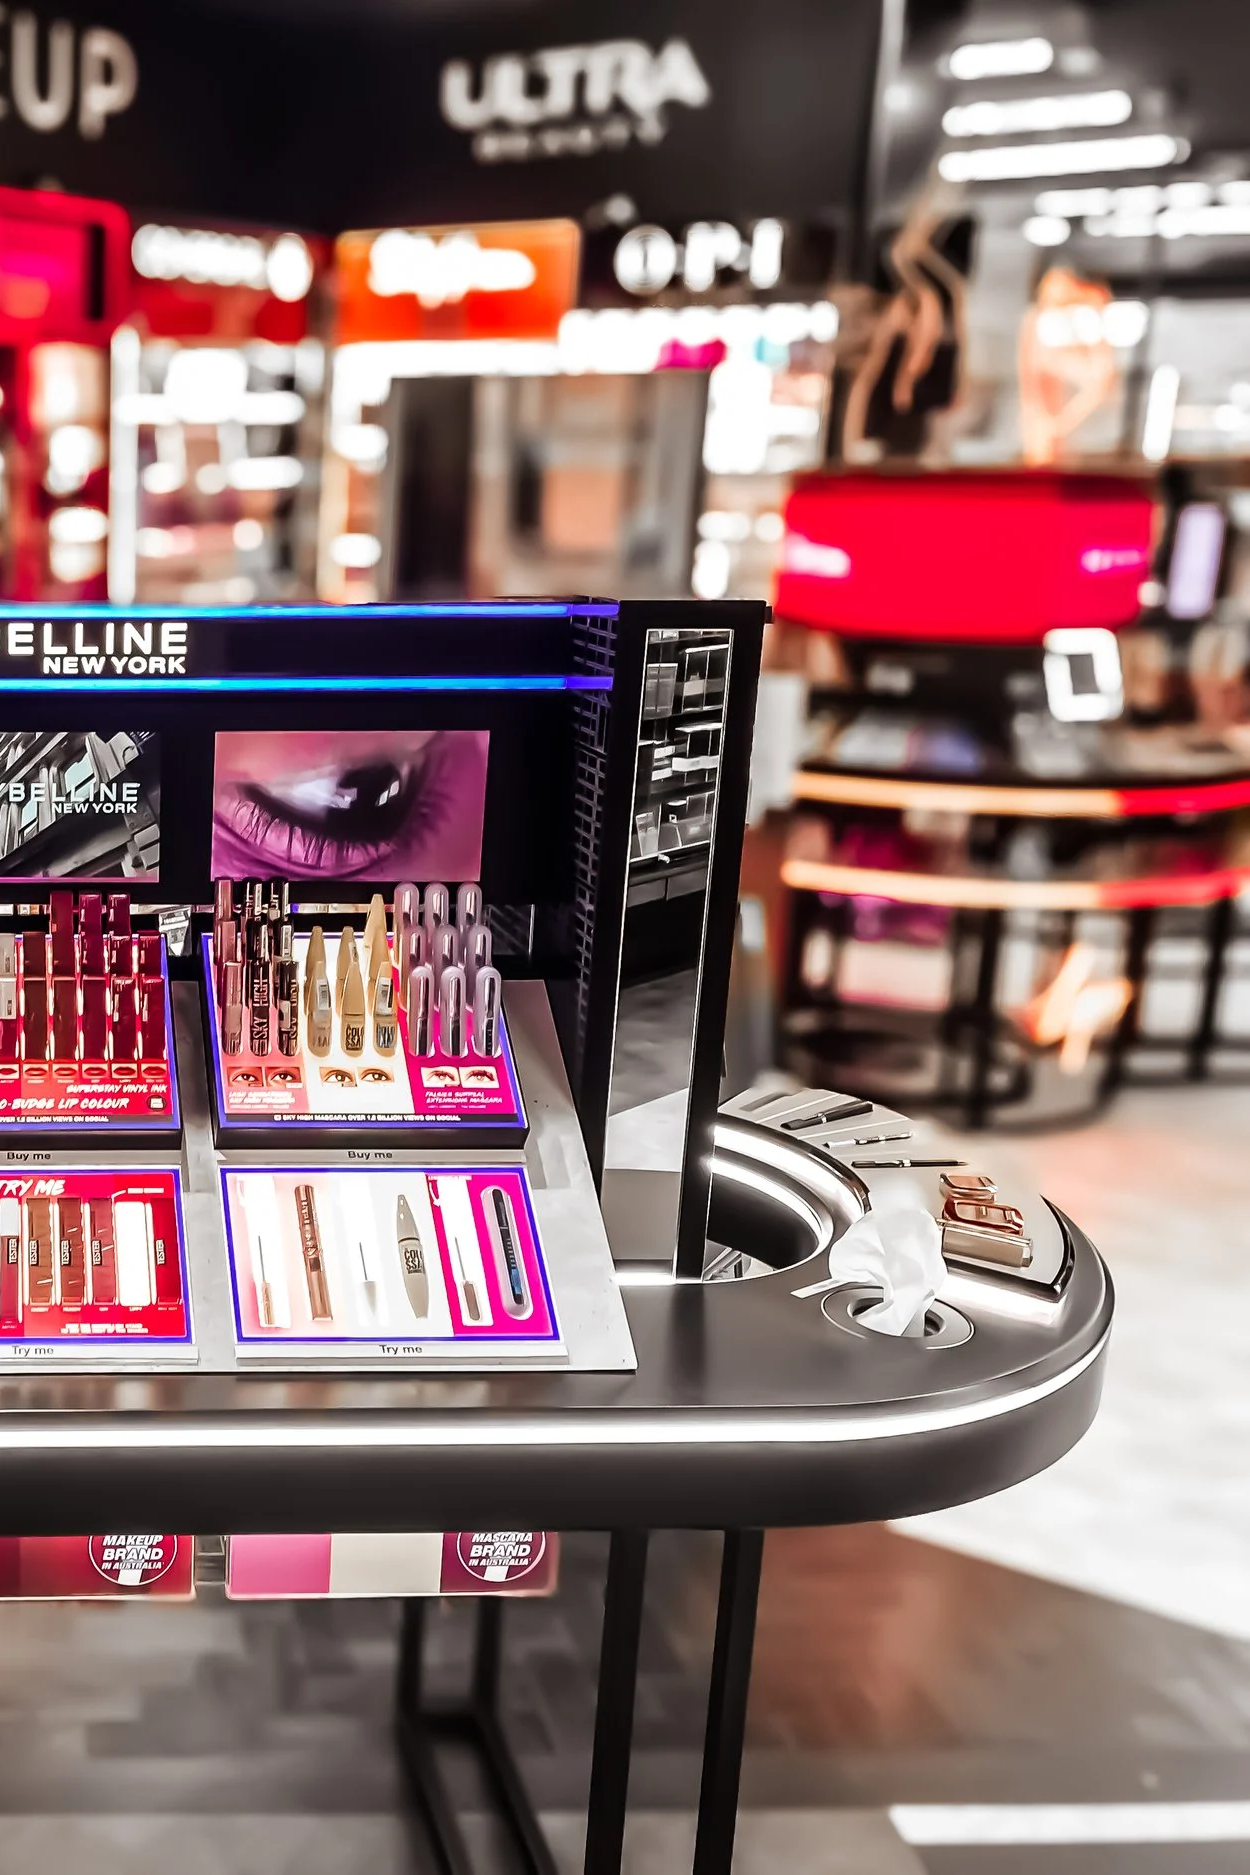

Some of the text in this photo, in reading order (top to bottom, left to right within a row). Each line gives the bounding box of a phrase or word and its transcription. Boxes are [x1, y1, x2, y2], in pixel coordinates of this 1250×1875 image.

[440, 36, 710, 130] ULTRA
[43, 656, 186, 674] NEW YORK
[51, 802, 138, 814] NEW YORK
[150, 1084, 167, 1093] INK
[58, 1098, 80, 1109] LIP
[80, 1097, 130, 1109] COLOUR
[7, 1151, 31, 1161] Buy
[347, 1151, 371, 1160] Buy
[34, 1178, 66, 1196] ME
[12, 1345, 54, 1356] Try me
[379, 1345, 422, 1356] Try me
[102, 1535, 164, 1546] MAKEUP
[471, 1532, 533, 1543] MASCARA
[102, 1548, 164, 1561] BRAND
[470, 1544, 531, 1558] BRAND
[101, 1562, 111, 1570] IN
[468, 1558, 478, 1566] IN
